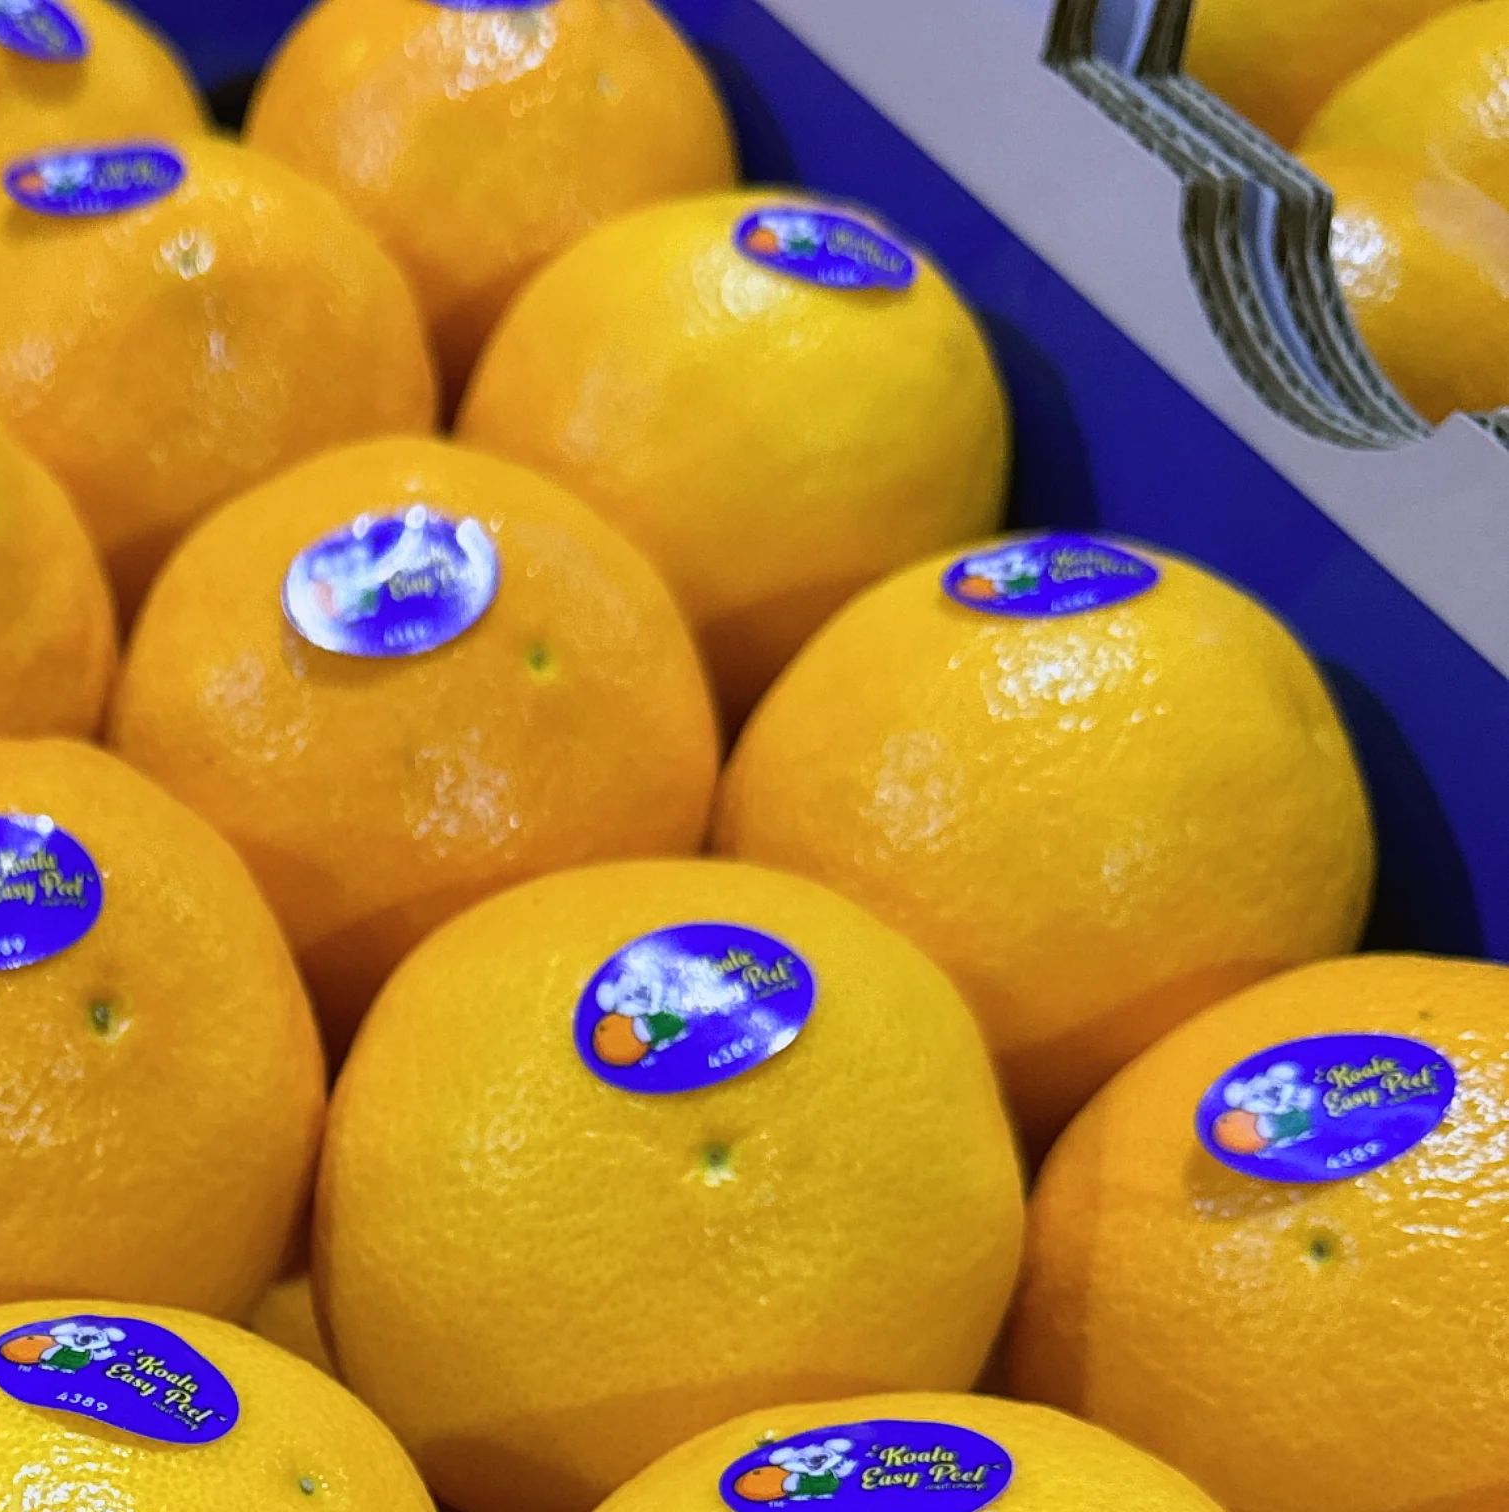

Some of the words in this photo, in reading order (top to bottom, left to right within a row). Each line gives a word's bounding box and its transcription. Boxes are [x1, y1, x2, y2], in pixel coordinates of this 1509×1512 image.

[136, 1355, 199, 1394] Koala
[56, 1391, 109, 1412] 4389
[105, 1363, 158, 1397] Easy
[165, 1389, 214, 1423] Peel
[878, 1446, 956, 1466] Koala
[861, 1467, 920, 1491] Easy
[929, 1464, 987, 1484] Peel
